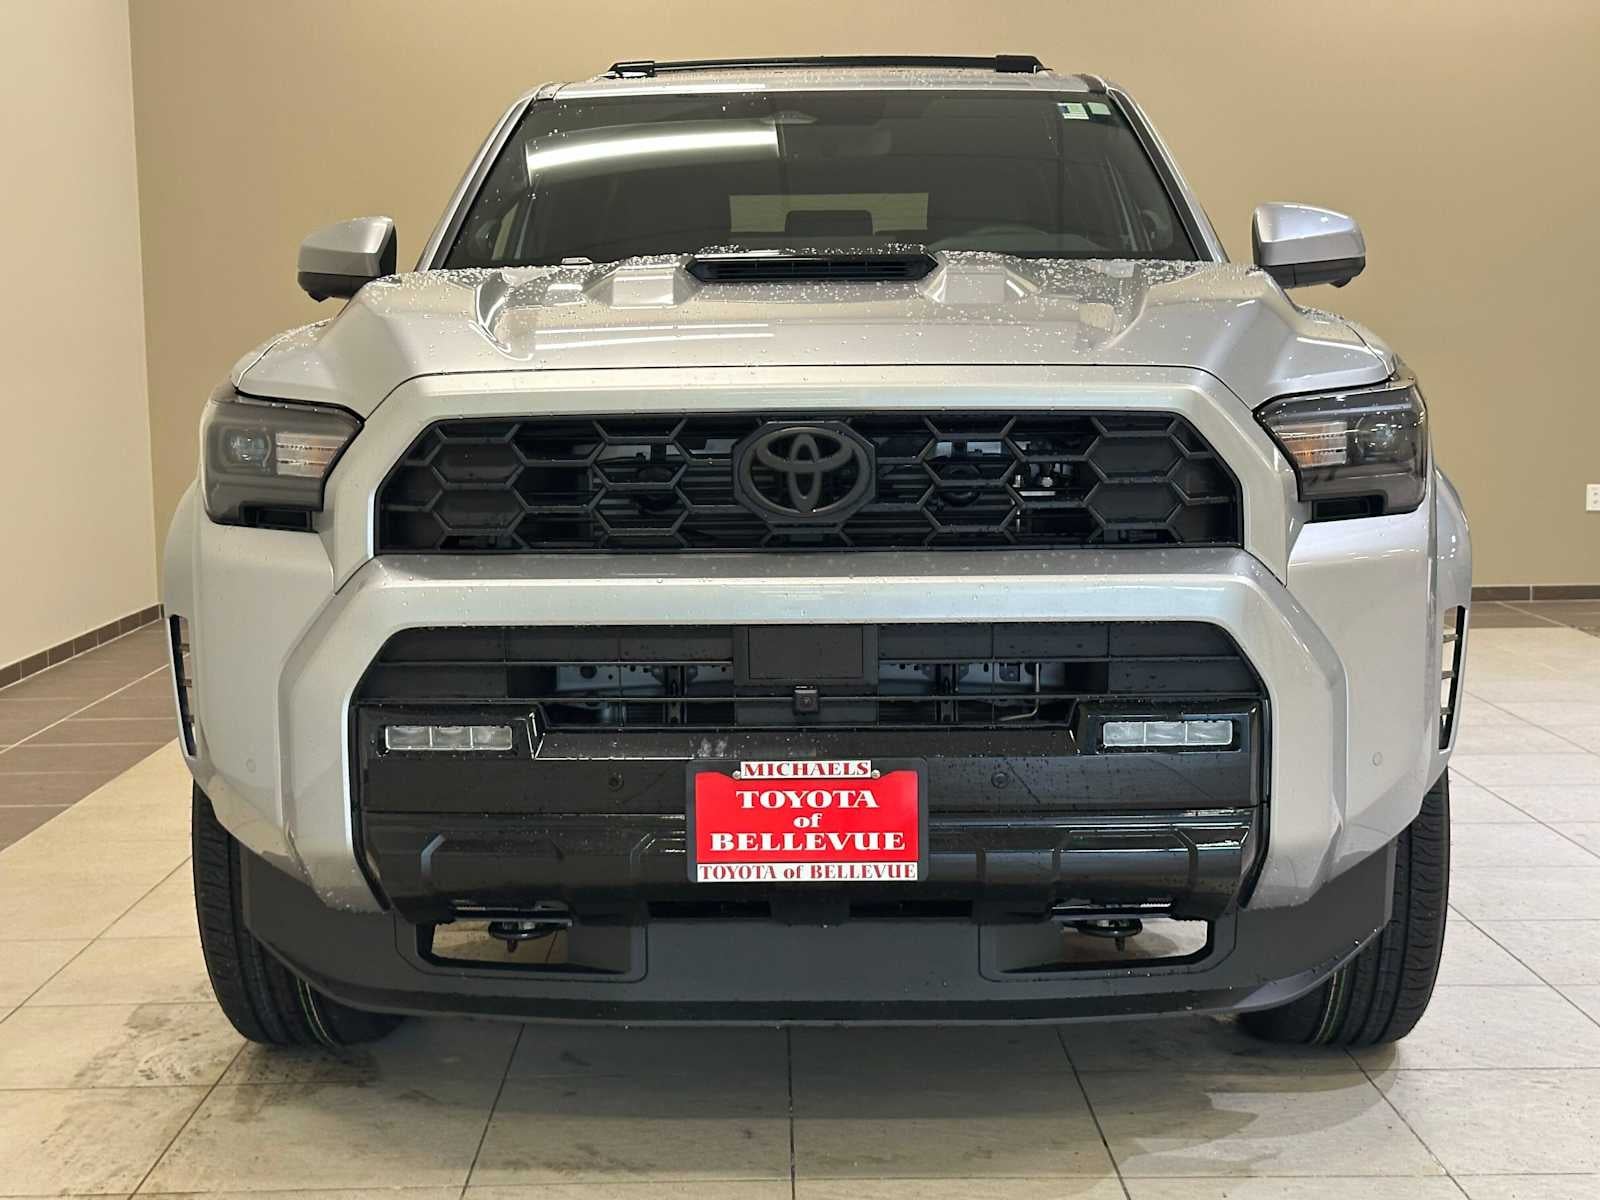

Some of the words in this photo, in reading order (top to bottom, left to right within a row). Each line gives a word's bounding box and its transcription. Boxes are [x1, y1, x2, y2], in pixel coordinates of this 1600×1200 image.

[743, 762, 869, 777] MICHAELS
[736, 790, 880, 809] TOYOTA
[792, 812, 823, 828] of
[710, 832, 905, 851] BELLEVUE
[699, 864, 776, 880] TOYOTA
[783, 864, 804, 880] of
[809, 864, 916, 880] BELLEVUE
